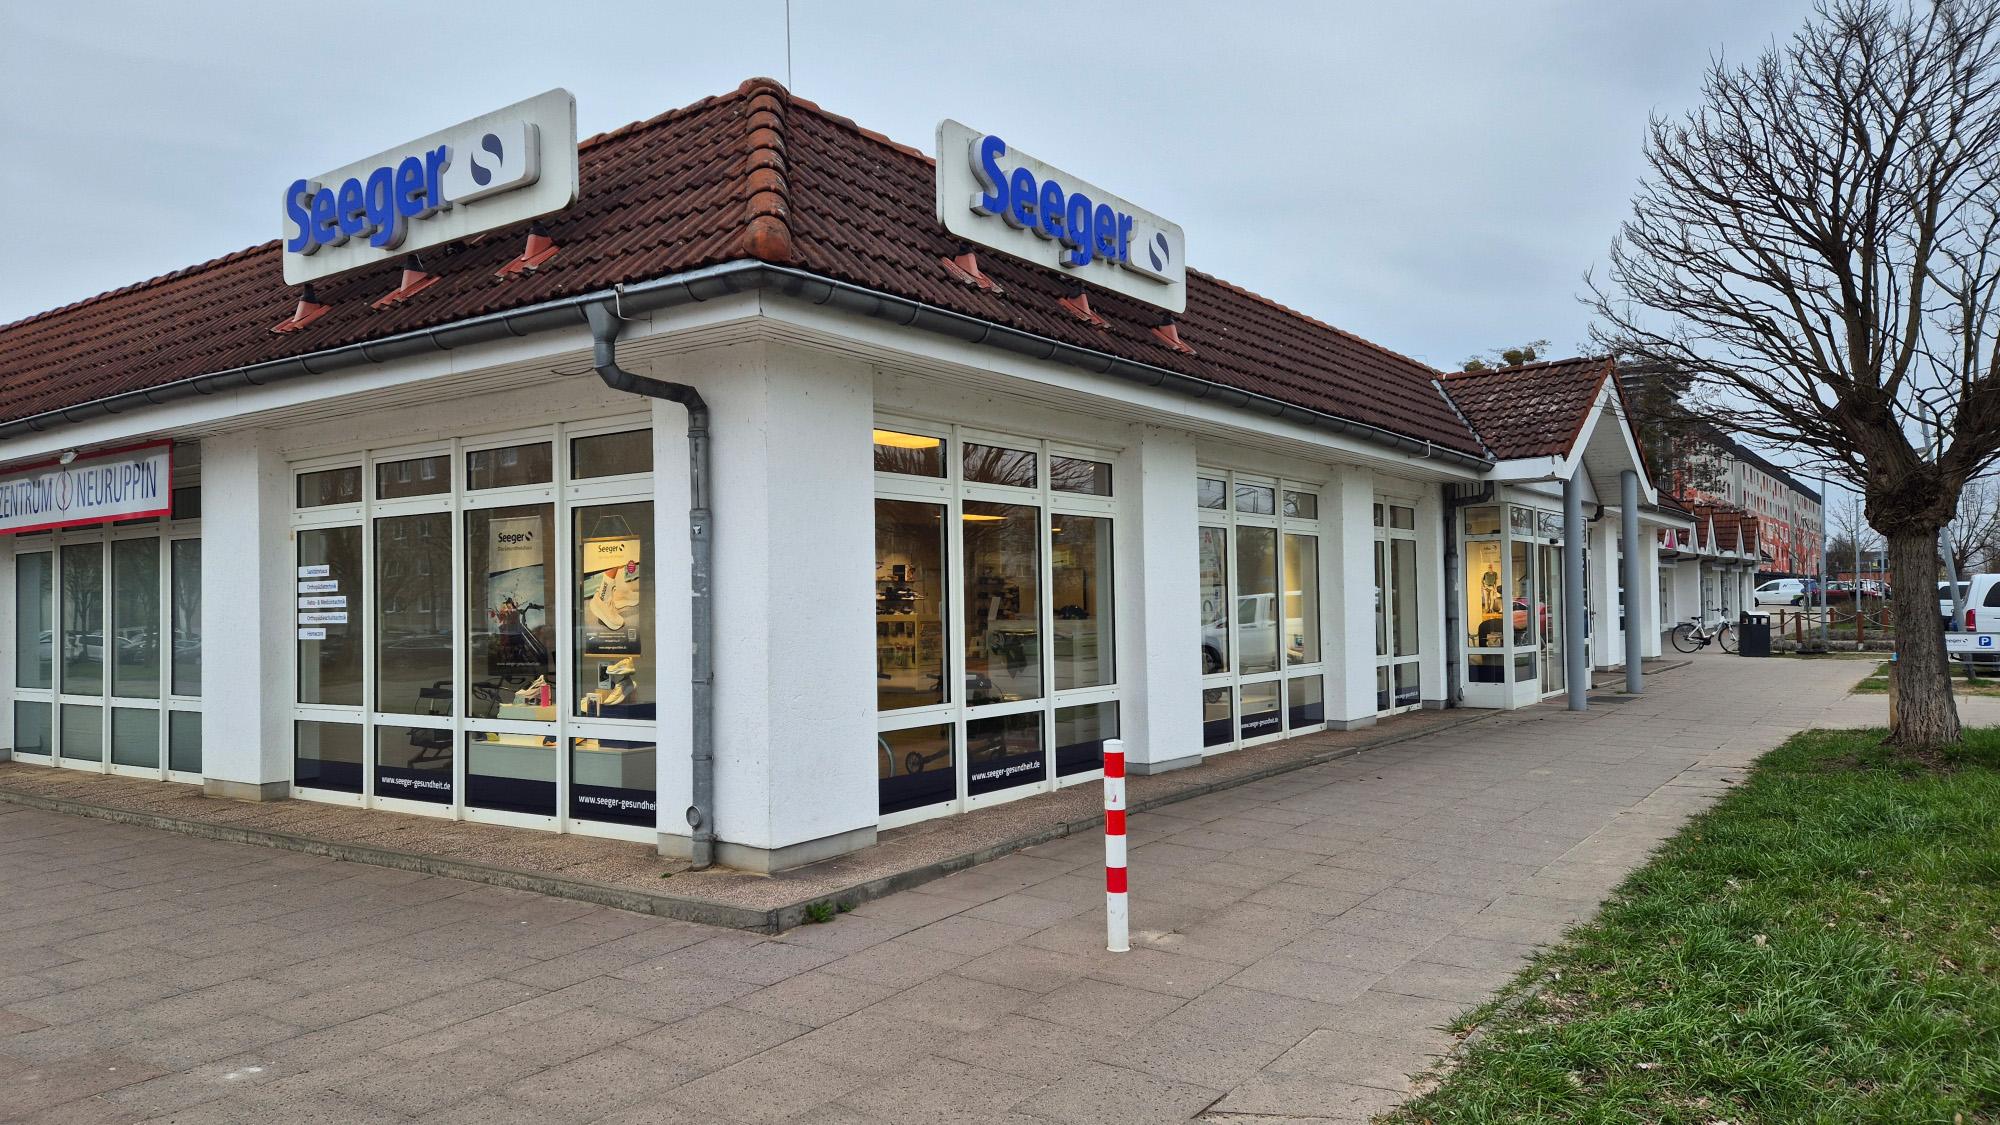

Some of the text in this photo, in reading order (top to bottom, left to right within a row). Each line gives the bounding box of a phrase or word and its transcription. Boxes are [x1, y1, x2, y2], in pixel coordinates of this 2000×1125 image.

[286, 144, 446, 253] Seeger
[982, 135, 1132, 266] Seeger
[76, 460, 157, 507] NEURUPPIN
[498, 532, 525, 544] Seeger
[598, 545, 618, 553] Seeger
[1981, 637, 1989, 645] P
[972, 760, 1040, 781] www.seeger-gesundheit.de
[381, 776, 450, 790] www.seeger-gesundheit.de
